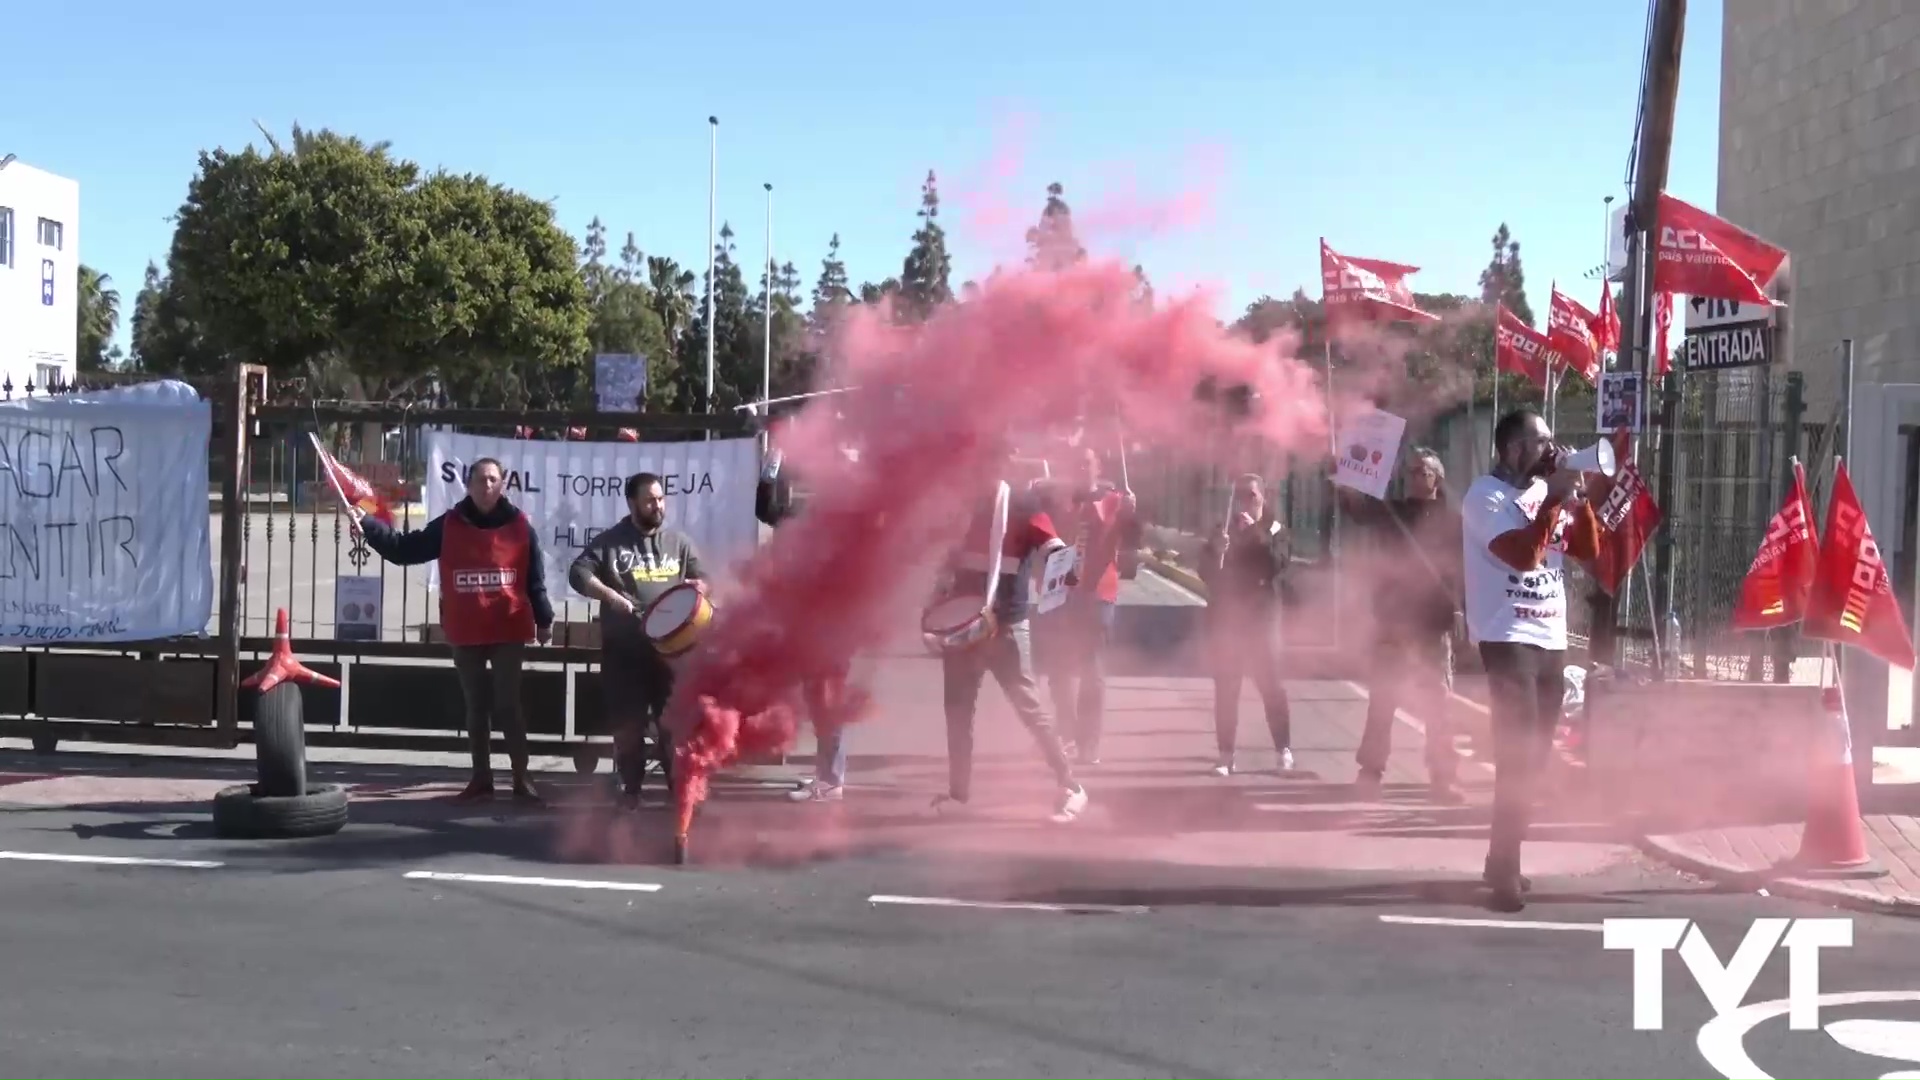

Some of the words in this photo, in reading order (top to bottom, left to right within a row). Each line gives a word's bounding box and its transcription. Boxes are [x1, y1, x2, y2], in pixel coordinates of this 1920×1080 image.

[1687, 327, 1765, 367] ENTRADA
[557, 472, 714, 497] TORREJA
[456, 571, 501, 586] CCOO
